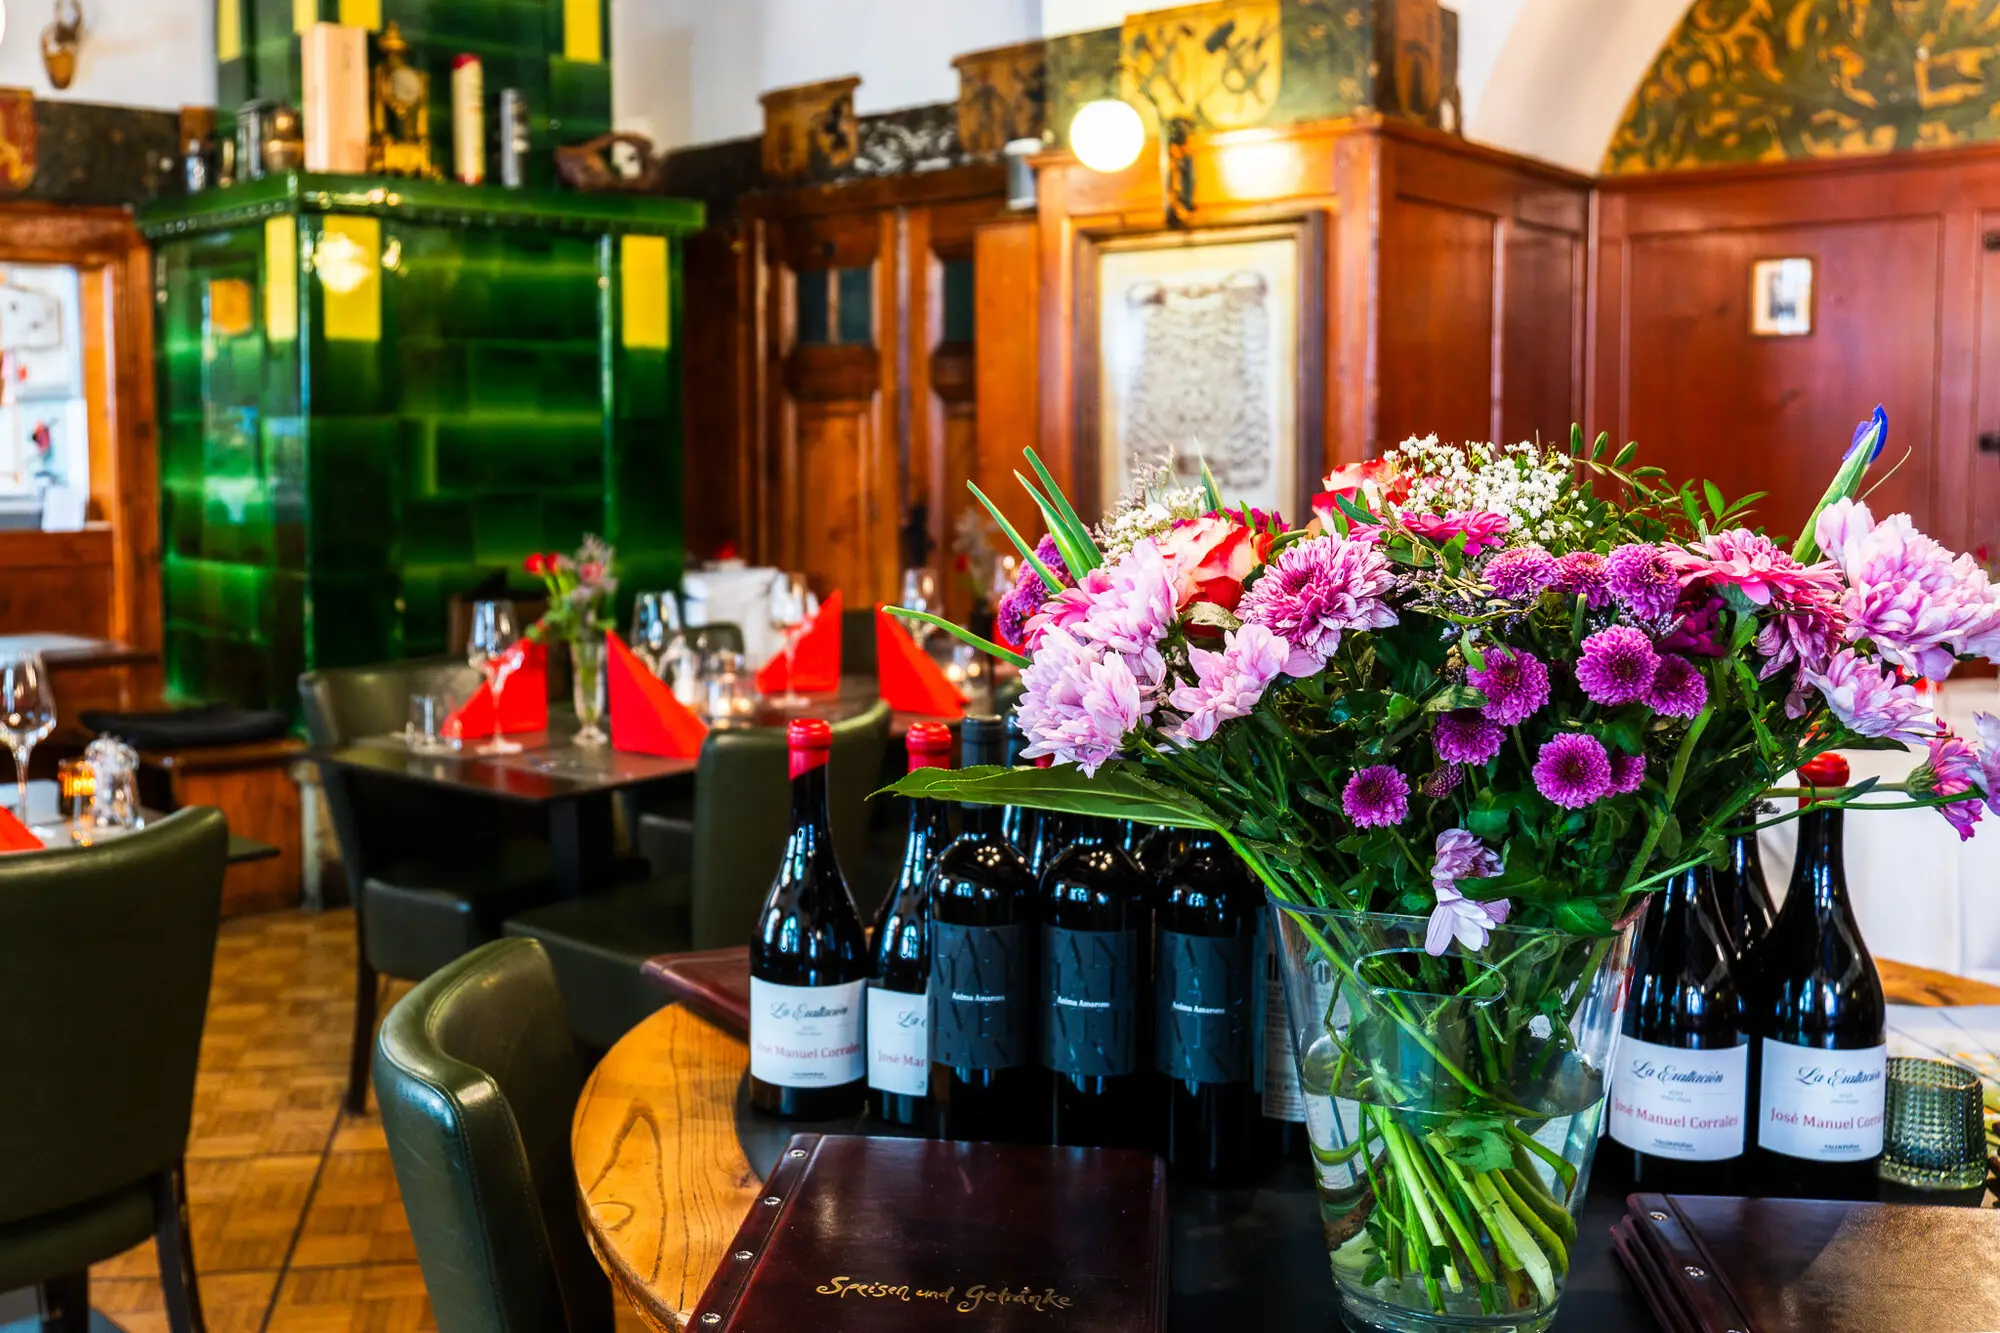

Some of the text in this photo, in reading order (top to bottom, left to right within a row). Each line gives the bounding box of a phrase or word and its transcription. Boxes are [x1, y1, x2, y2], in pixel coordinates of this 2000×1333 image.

[775, 1045, 818, 1060] Manuel
[1632, 1059, 1655, 1079] La
[1796, 1065, 1825, 1086] La
[1636, 1107, 1686, 1129] Manuel
[1689, 1114, 1739, 1130] Corrales
[1770, 1106, 1799, 1125] José
[1803, 1114, 1854, 1130] Manuel
[816, 1276, 1074, 1313] Speisen und Getränke
